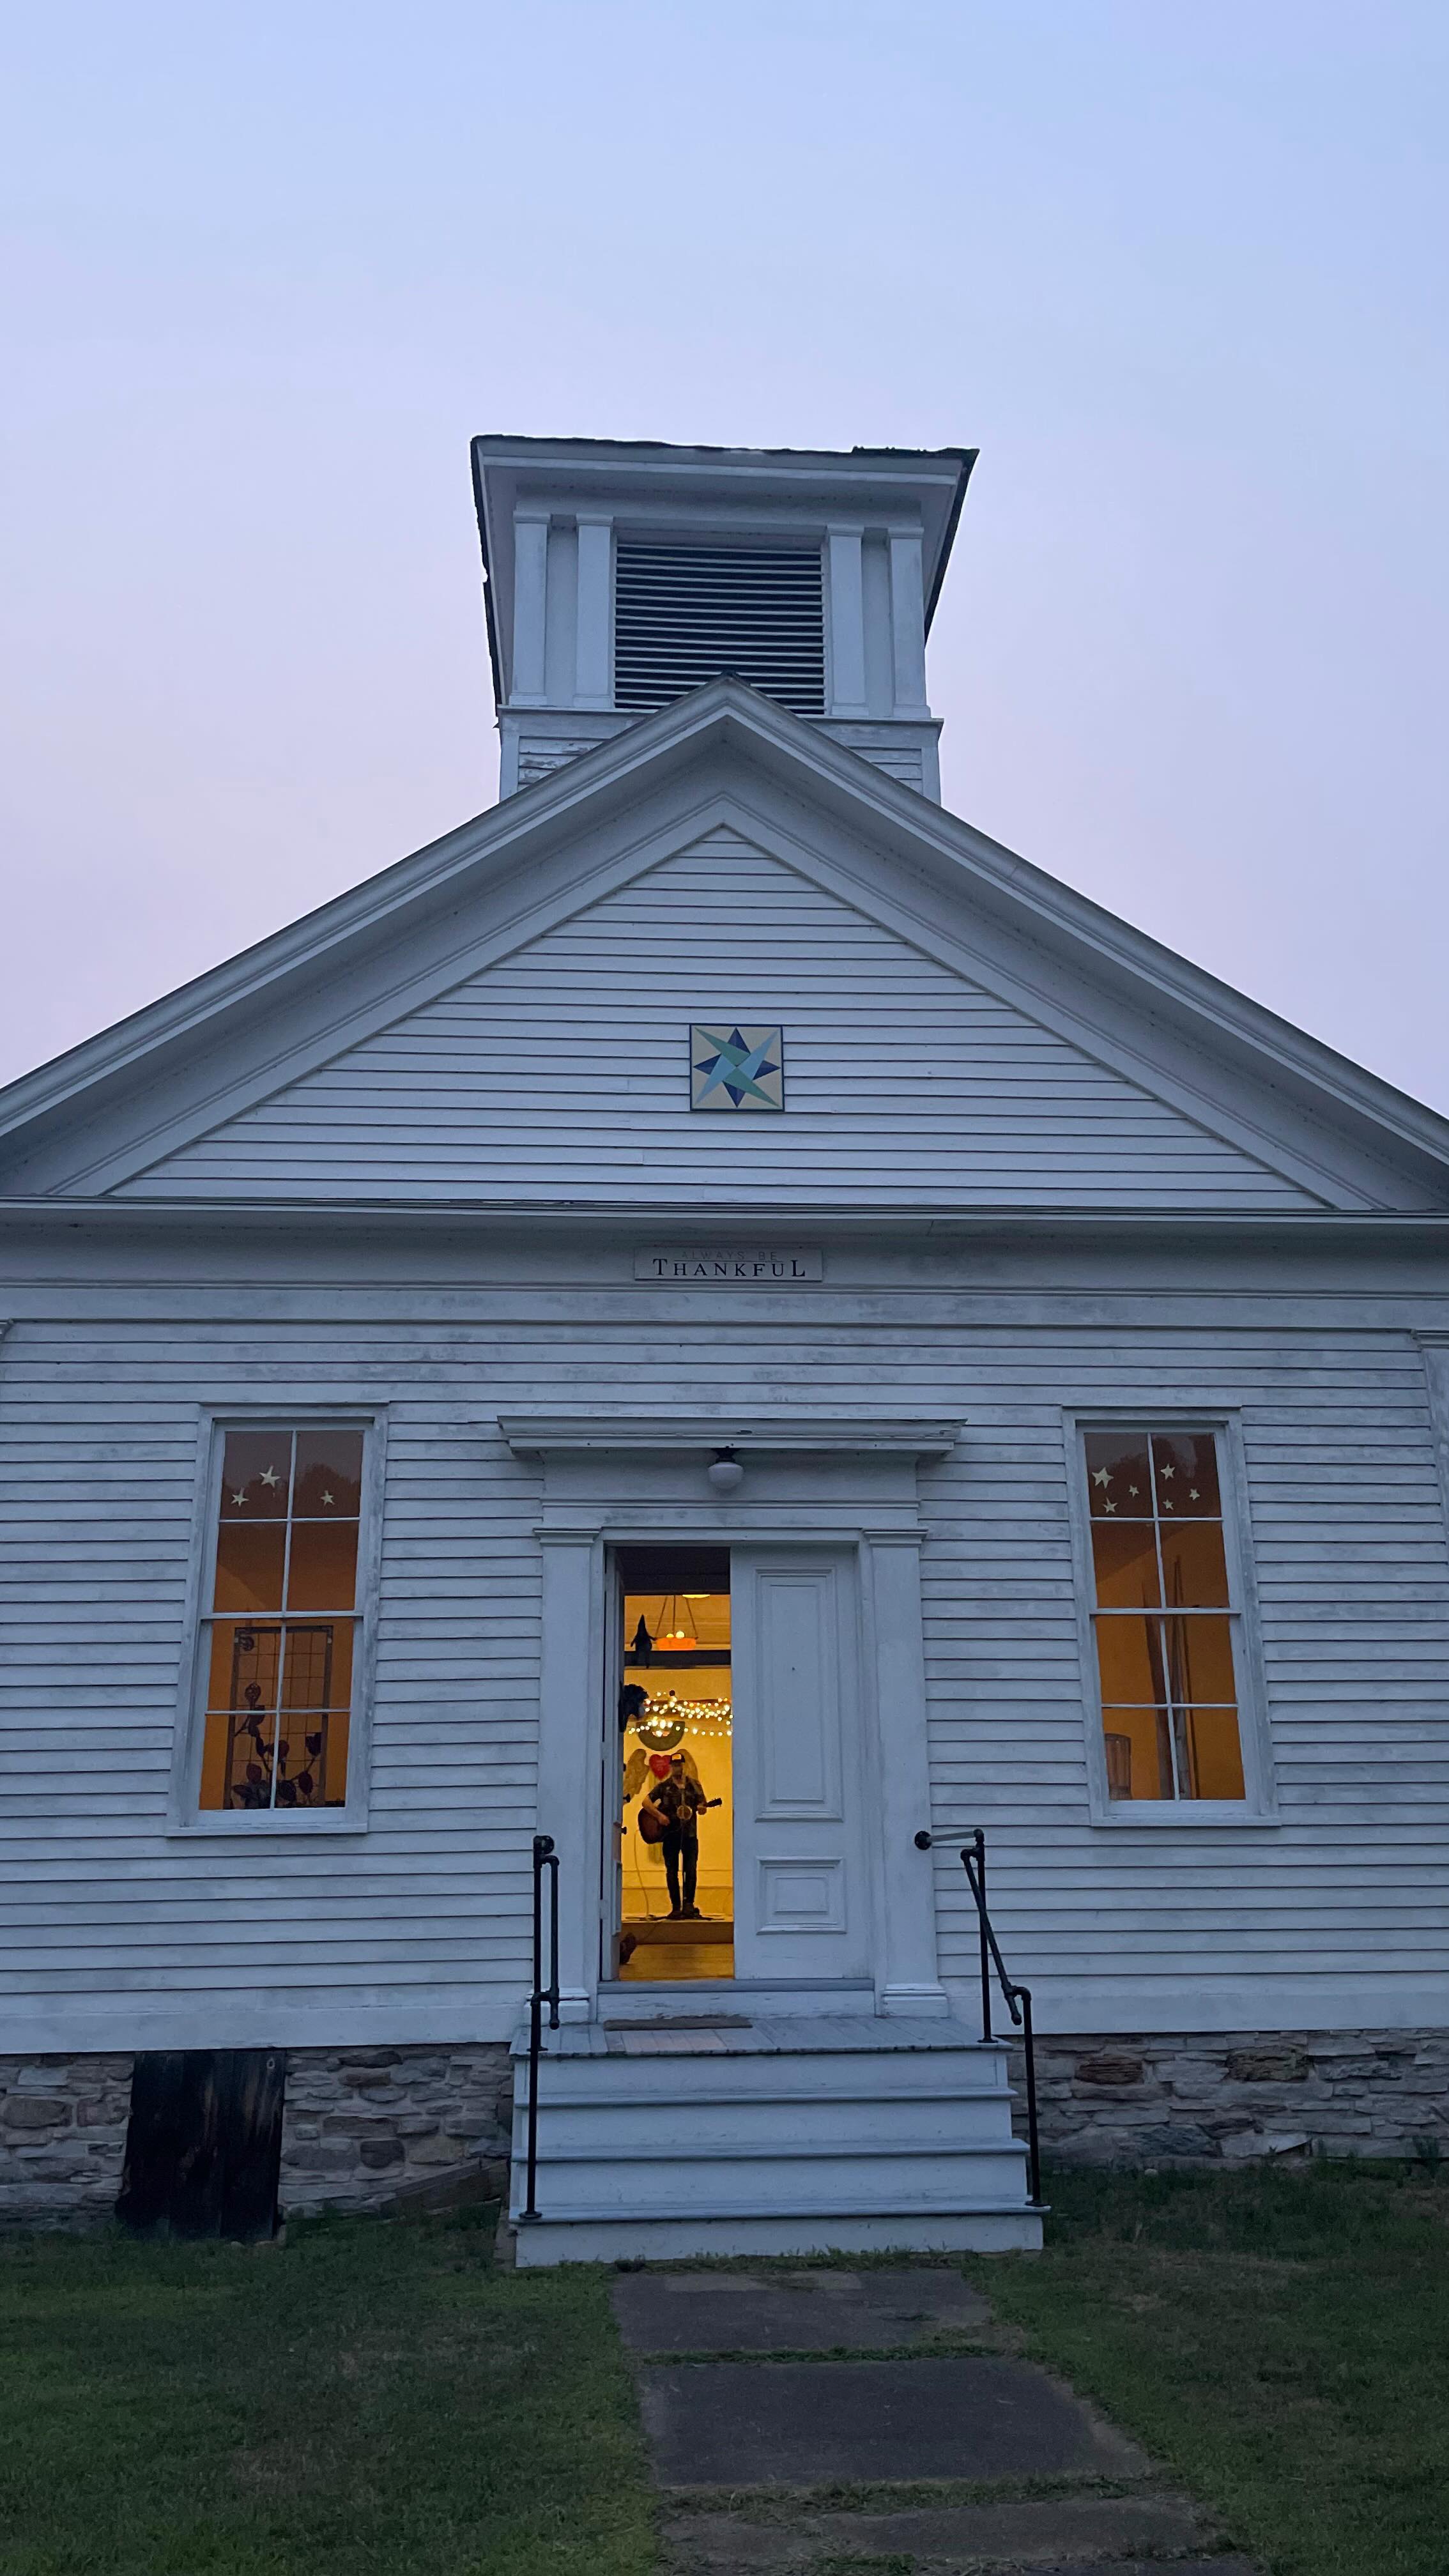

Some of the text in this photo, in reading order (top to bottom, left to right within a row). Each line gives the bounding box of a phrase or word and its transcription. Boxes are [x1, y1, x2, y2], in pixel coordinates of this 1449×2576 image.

[681, 1251, 777, 1261] ALWAYS BE
[653, 1259, 805, 1276] THANKFUL
